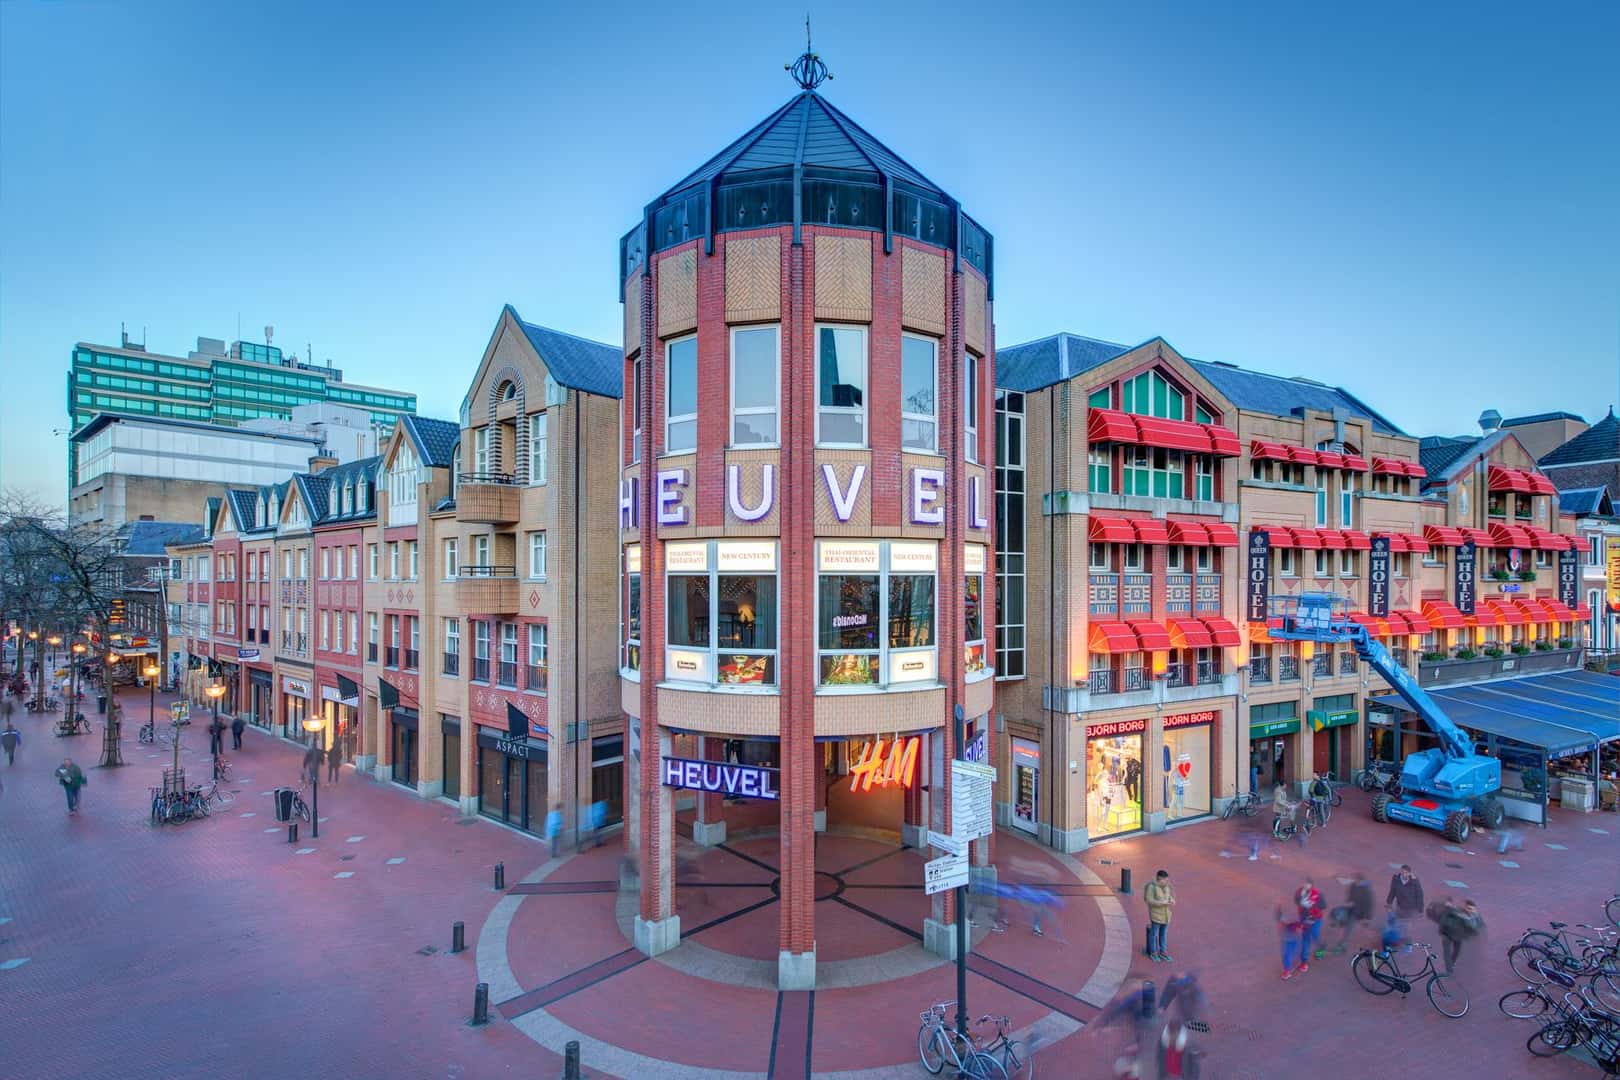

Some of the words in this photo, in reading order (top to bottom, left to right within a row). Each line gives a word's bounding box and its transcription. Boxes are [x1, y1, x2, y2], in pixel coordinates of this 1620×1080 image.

[620, 463, 988, 528] HEUVEL
[721, 553, 737, 561] NEW
[738, 552, 771, 560] CENTURY
[824, 556, 876, 564] RESTAURANT
[1251, 557, 1265, 619] HOTEL
[1372, 560, 1386, 615] HOTEL
[1458, 562, 1472, 612] HOTEL
[1561, 564, 1575, 607] HOTEL
[1118, 720, 1145, 733] BORG
[1190, 711, 1213, 723] BORG
[496, 740, 529, 759] ASPACT
[850, 736, 920, 793] H&M
[666, 759, 778, 798] HEUVEL
